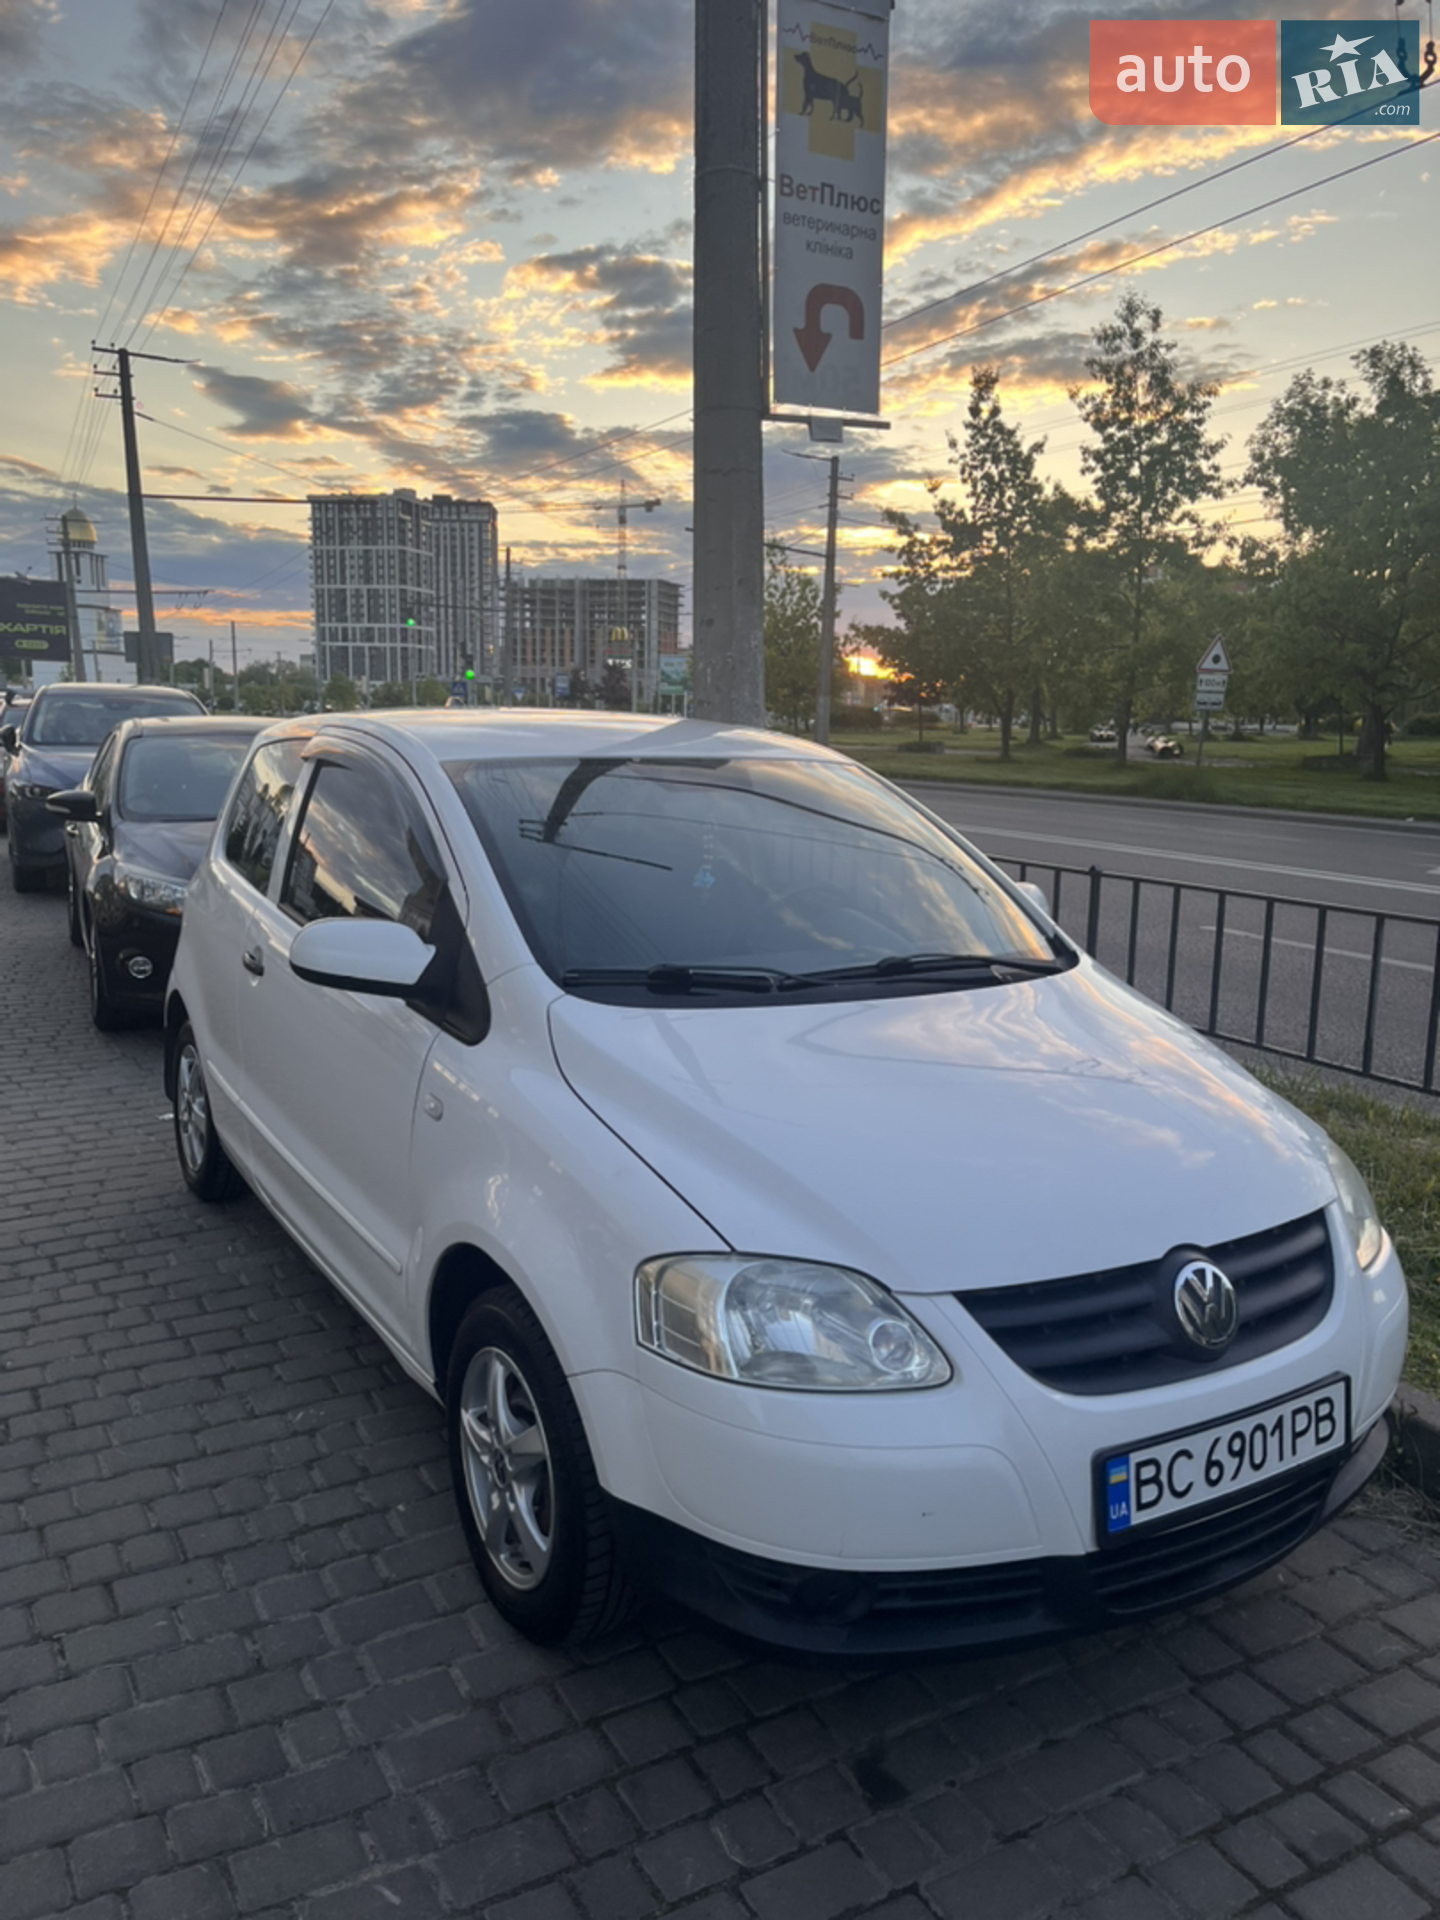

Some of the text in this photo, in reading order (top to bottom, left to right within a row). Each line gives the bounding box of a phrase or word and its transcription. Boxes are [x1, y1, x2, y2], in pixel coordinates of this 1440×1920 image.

[780, 173, 882, 215] ВетПлюс
[783, 211, 877, 241] ветеринарна
[806, 238, 853, 259] клініка
[1204, 1414, 1284, 1488] 6901
[1110, 1501, 1128, 1520] UA
